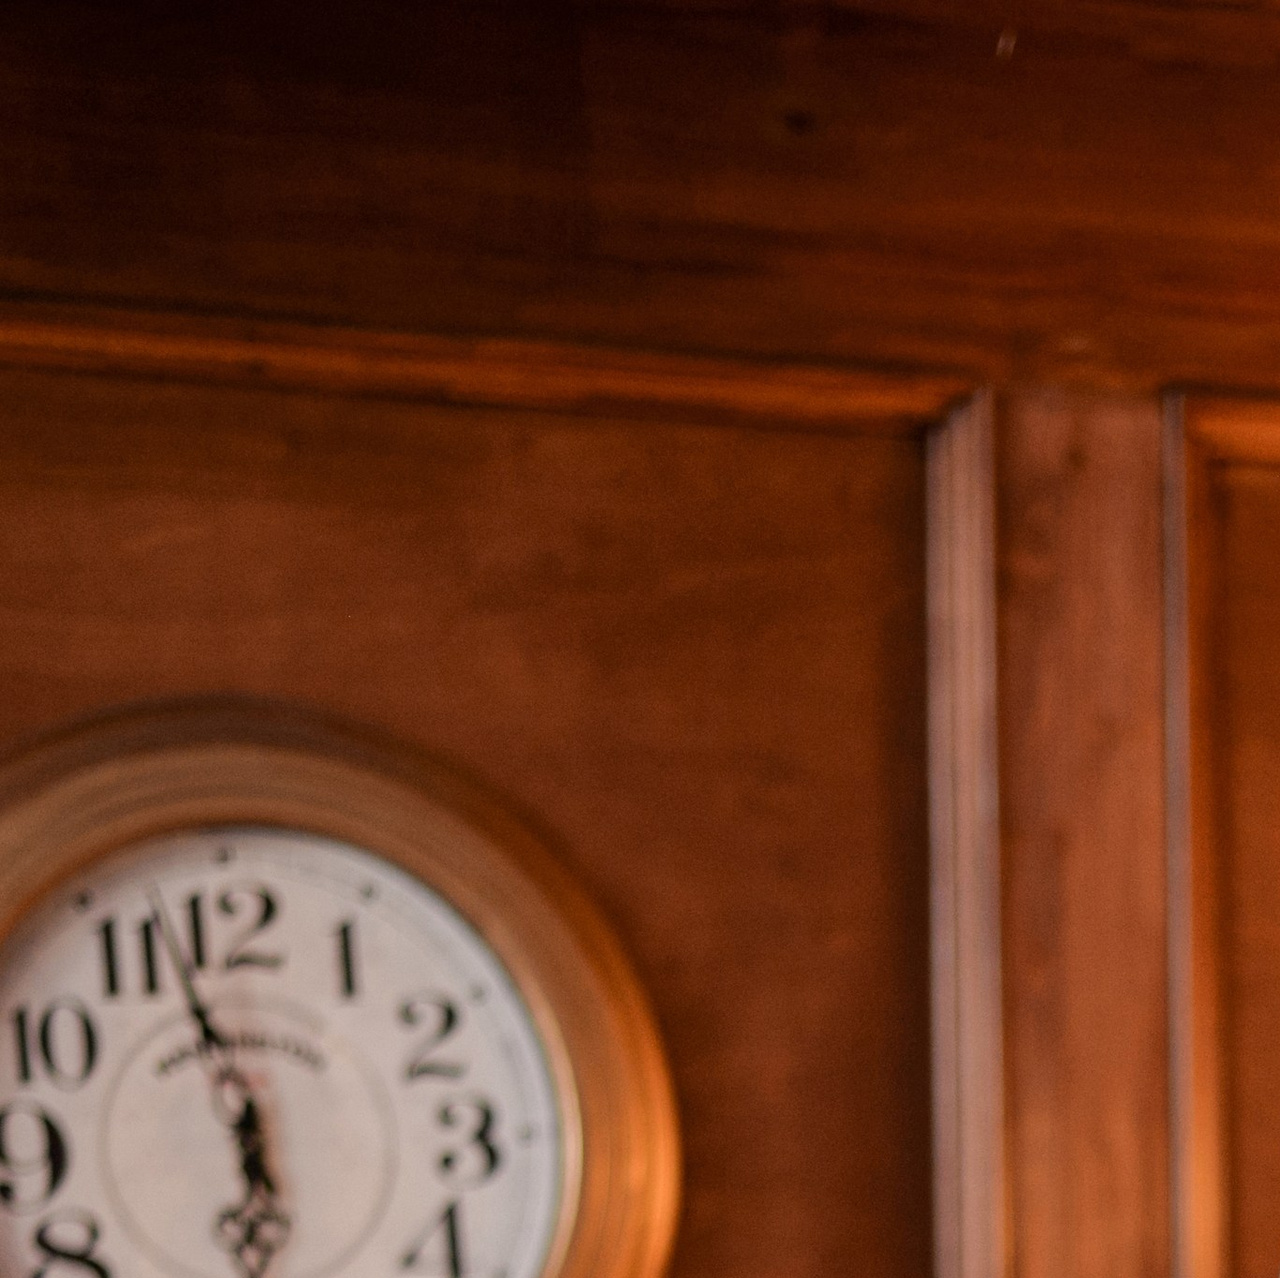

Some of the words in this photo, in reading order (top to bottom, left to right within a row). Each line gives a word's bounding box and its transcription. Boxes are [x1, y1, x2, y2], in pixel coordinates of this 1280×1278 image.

[98, 917, 159, 997] 11
[188, 884, 287, 970] 12
[336, 920, 357, 997] 1
[13, 996, 100, 1090] 10
[398, 997, 467, 1081] 2
[0, 1103, 69, 1212] 9
[438, 1099, 501, 1185] 3
